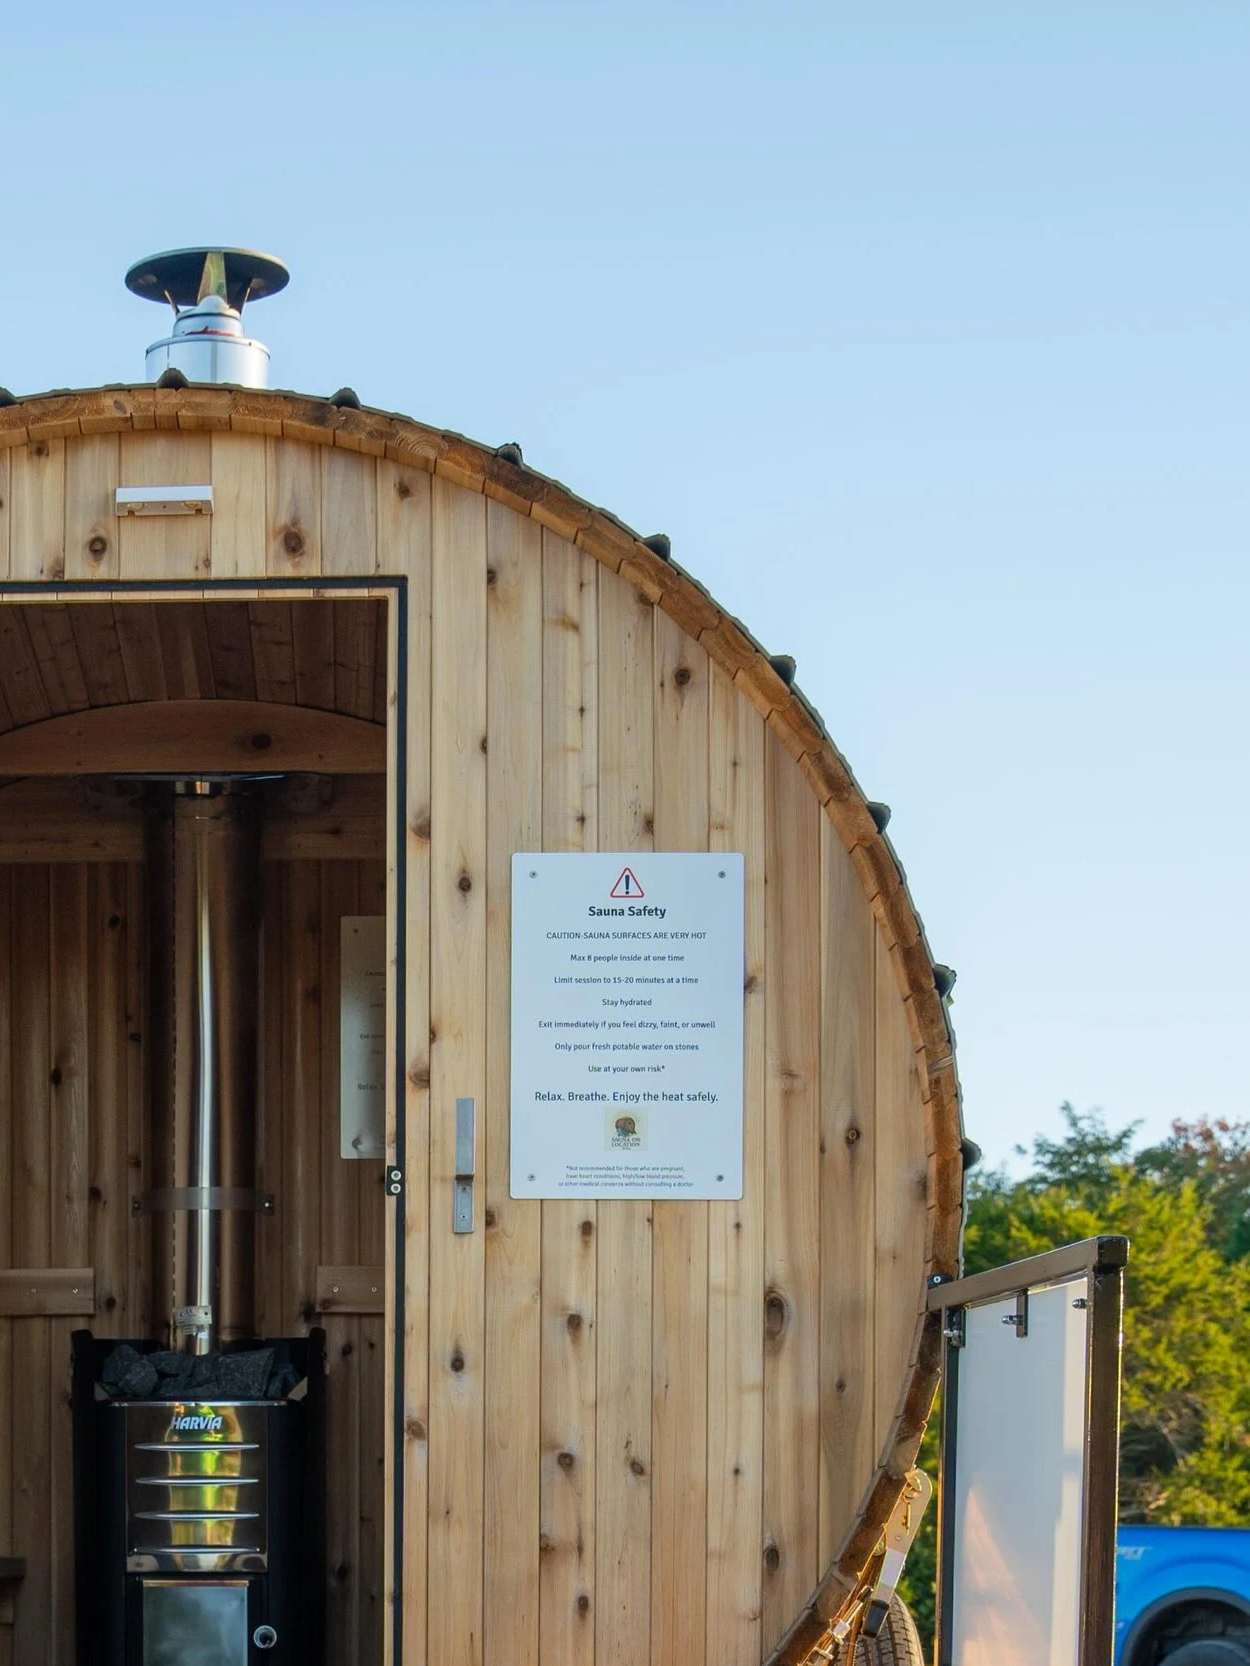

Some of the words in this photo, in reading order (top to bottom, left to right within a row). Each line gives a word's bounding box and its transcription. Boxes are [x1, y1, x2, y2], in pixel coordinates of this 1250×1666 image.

[588, 906, 625, 917] Sauna
[628, 906, 666, 919] Safety
[593, 954, 618, 963] people
[602, 999, 618, 1007] Stay
[620, 999, 652, 1007] hydrated
[554, 1021, 599, 1029] immediately
[608, 1022, 621, 1030] you
[638, 1021, 658, 1030] dizzy,
[660, 1021, 679, 1029] faint,
[555, 1043, 572, 1052] Only
[573, 1044, 590, 1052] pour
[612, 1043, 639, 1052] potable
[535, 1092, 564, 1101] Relax.
[568, 1092, 609, 1101] Breathe.
[612, 1092, 640, 1103] Enjoy
[643, 1092, 659, 1101] the
[662, 1092, 684, 1101] heat
[686, 1092, 718, 1103] safely.
[171, 1416, 222, 1430] HARVIA
